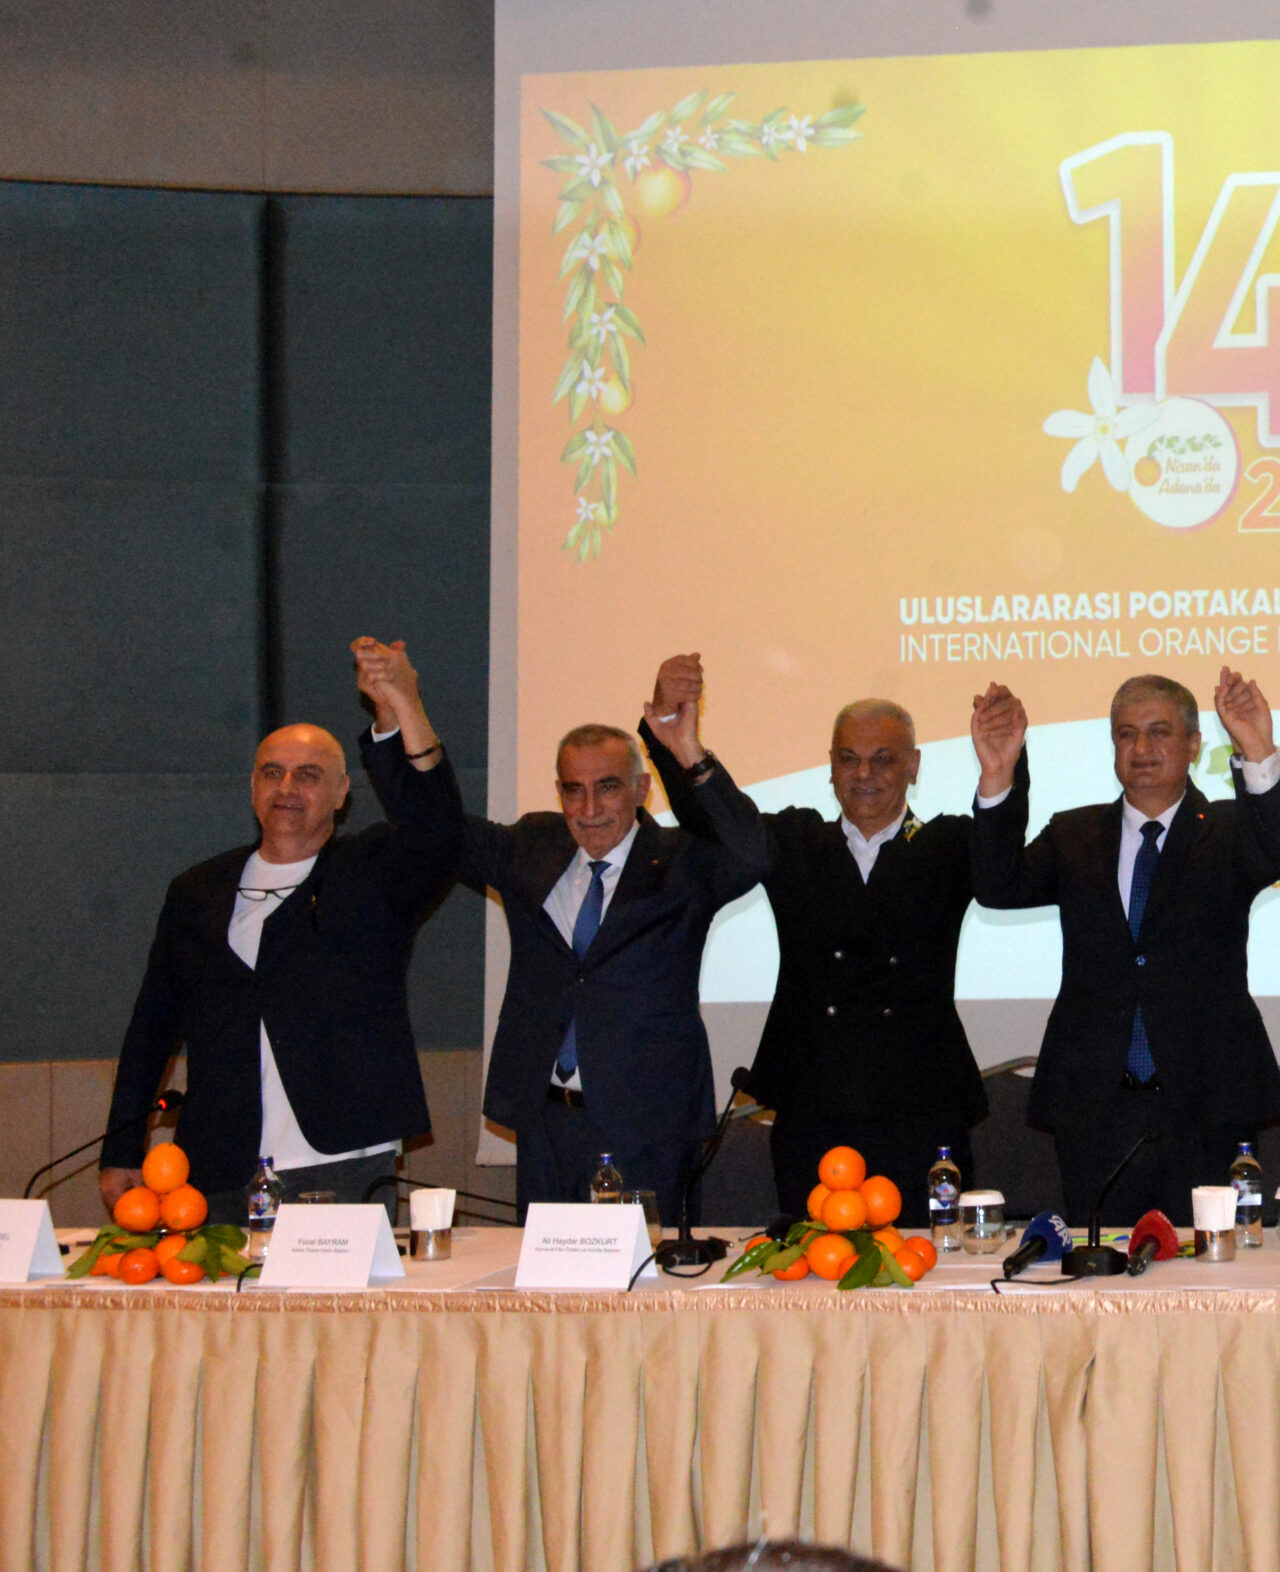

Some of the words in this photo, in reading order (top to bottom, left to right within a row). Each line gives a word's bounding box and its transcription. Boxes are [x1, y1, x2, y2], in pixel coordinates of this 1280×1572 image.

[900, 590, 1121, 625] ULUSLARARASI
[900, 629, 1131, 663] INTERNATIONAL
[1139, 625, 1268, 656] ORANGE
[579, 1237, 618, 1246] BOZKURT
